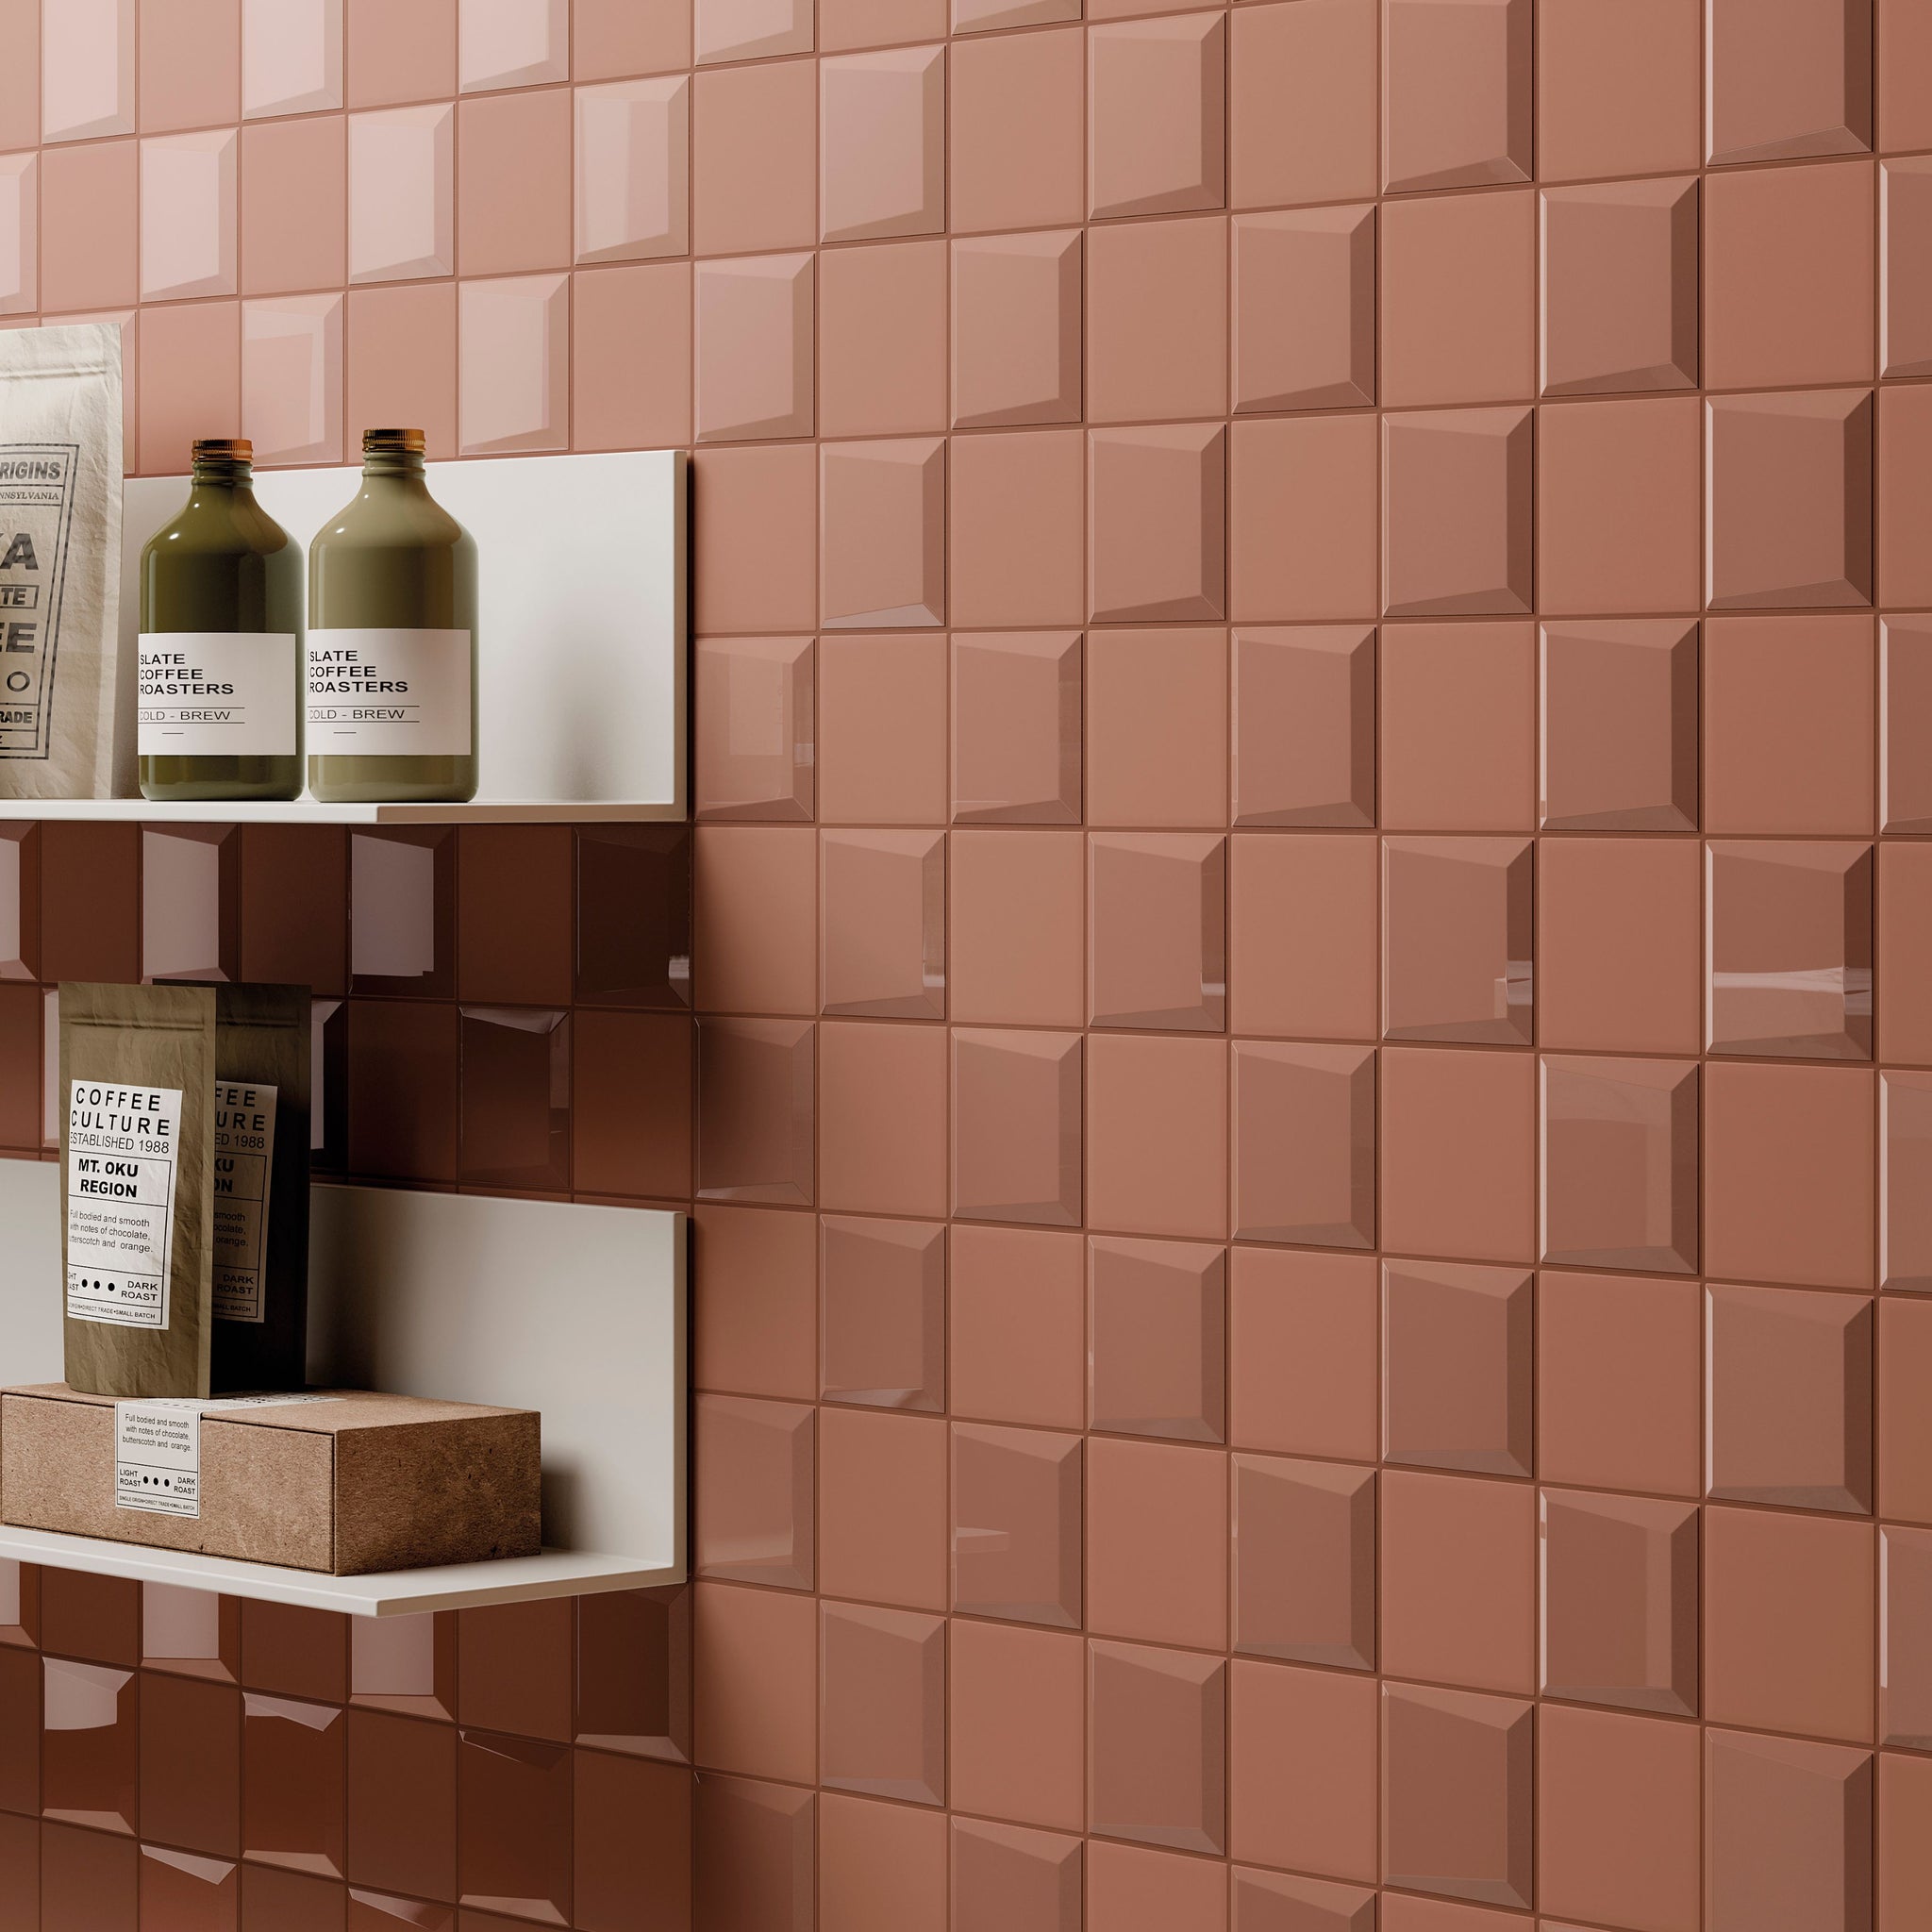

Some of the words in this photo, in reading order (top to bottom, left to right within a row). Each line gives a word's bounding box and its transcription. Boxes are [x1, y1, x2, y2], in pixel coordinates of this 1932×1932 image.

[140, 654, 185, 665] SLATE
[309, 650, 358, 662] SLATE
[140, 669, 203, 680] COFFEE
[309, 666, 377, 677] COFFEE
[140, 684, 234, 694] ROASTERS
[309, 681, 408, 692] ROASTERS
[140, 711, 165, 721] COLD
[180, 711, 231, 721] BREW
[309, 709, 337, 720] COLD
[353, 709, 406, 719] BREW
[75, 1088, 160, 1111] COFFEE
[71, 1110, 170, 1136] CULTURE
[216, 1111, 265, 1131] URE
[70, 1132, 134, 1151] ESTABLISHED
[139, 1140, 170, 1154] 1988
[234, 1135, 264, 1149] 1988
[78, 1158, 101, 1174] MT.
[105, 1161, 139, 1177] OKU
[80, 1179, 137, 1198] REGION
[79, 1211, 102, 1222] bodied
[103, 1215, 117, 1224] and
[119, 1218, 150, 1227] smooth
[80, 1224, 99, 1234] notes
[100, 1226, 108, 1235] of
[102, 1240, 116, 1249] and
[120, 1241, 153, 1254] orange.
[224, 1274, 254, 1285] DARK
[127, 1281, 158, 1291] DARK
[217, 1284, 253, 1294] ROAST
[121, 1291, 158, 1301] ROAST
[125, 1413, 135, 1422] Full
[136, 1416, 156, 1425] bodied
[157, 1418, 168, 1426] and
[168, 1421, 190, 1429] smooth
[125, 1425, 137, 1434] with
[155, 1428, 161, 1437] of
[122, 1435, 156, 1447] butterscotch
[120, 1469, 138, 1477] LIGHT
[120, 1477, 142, 1487] ROAST
[177, 1476, 196, 1486] DARK
[174, 1485, 196, 1495] ROAST
